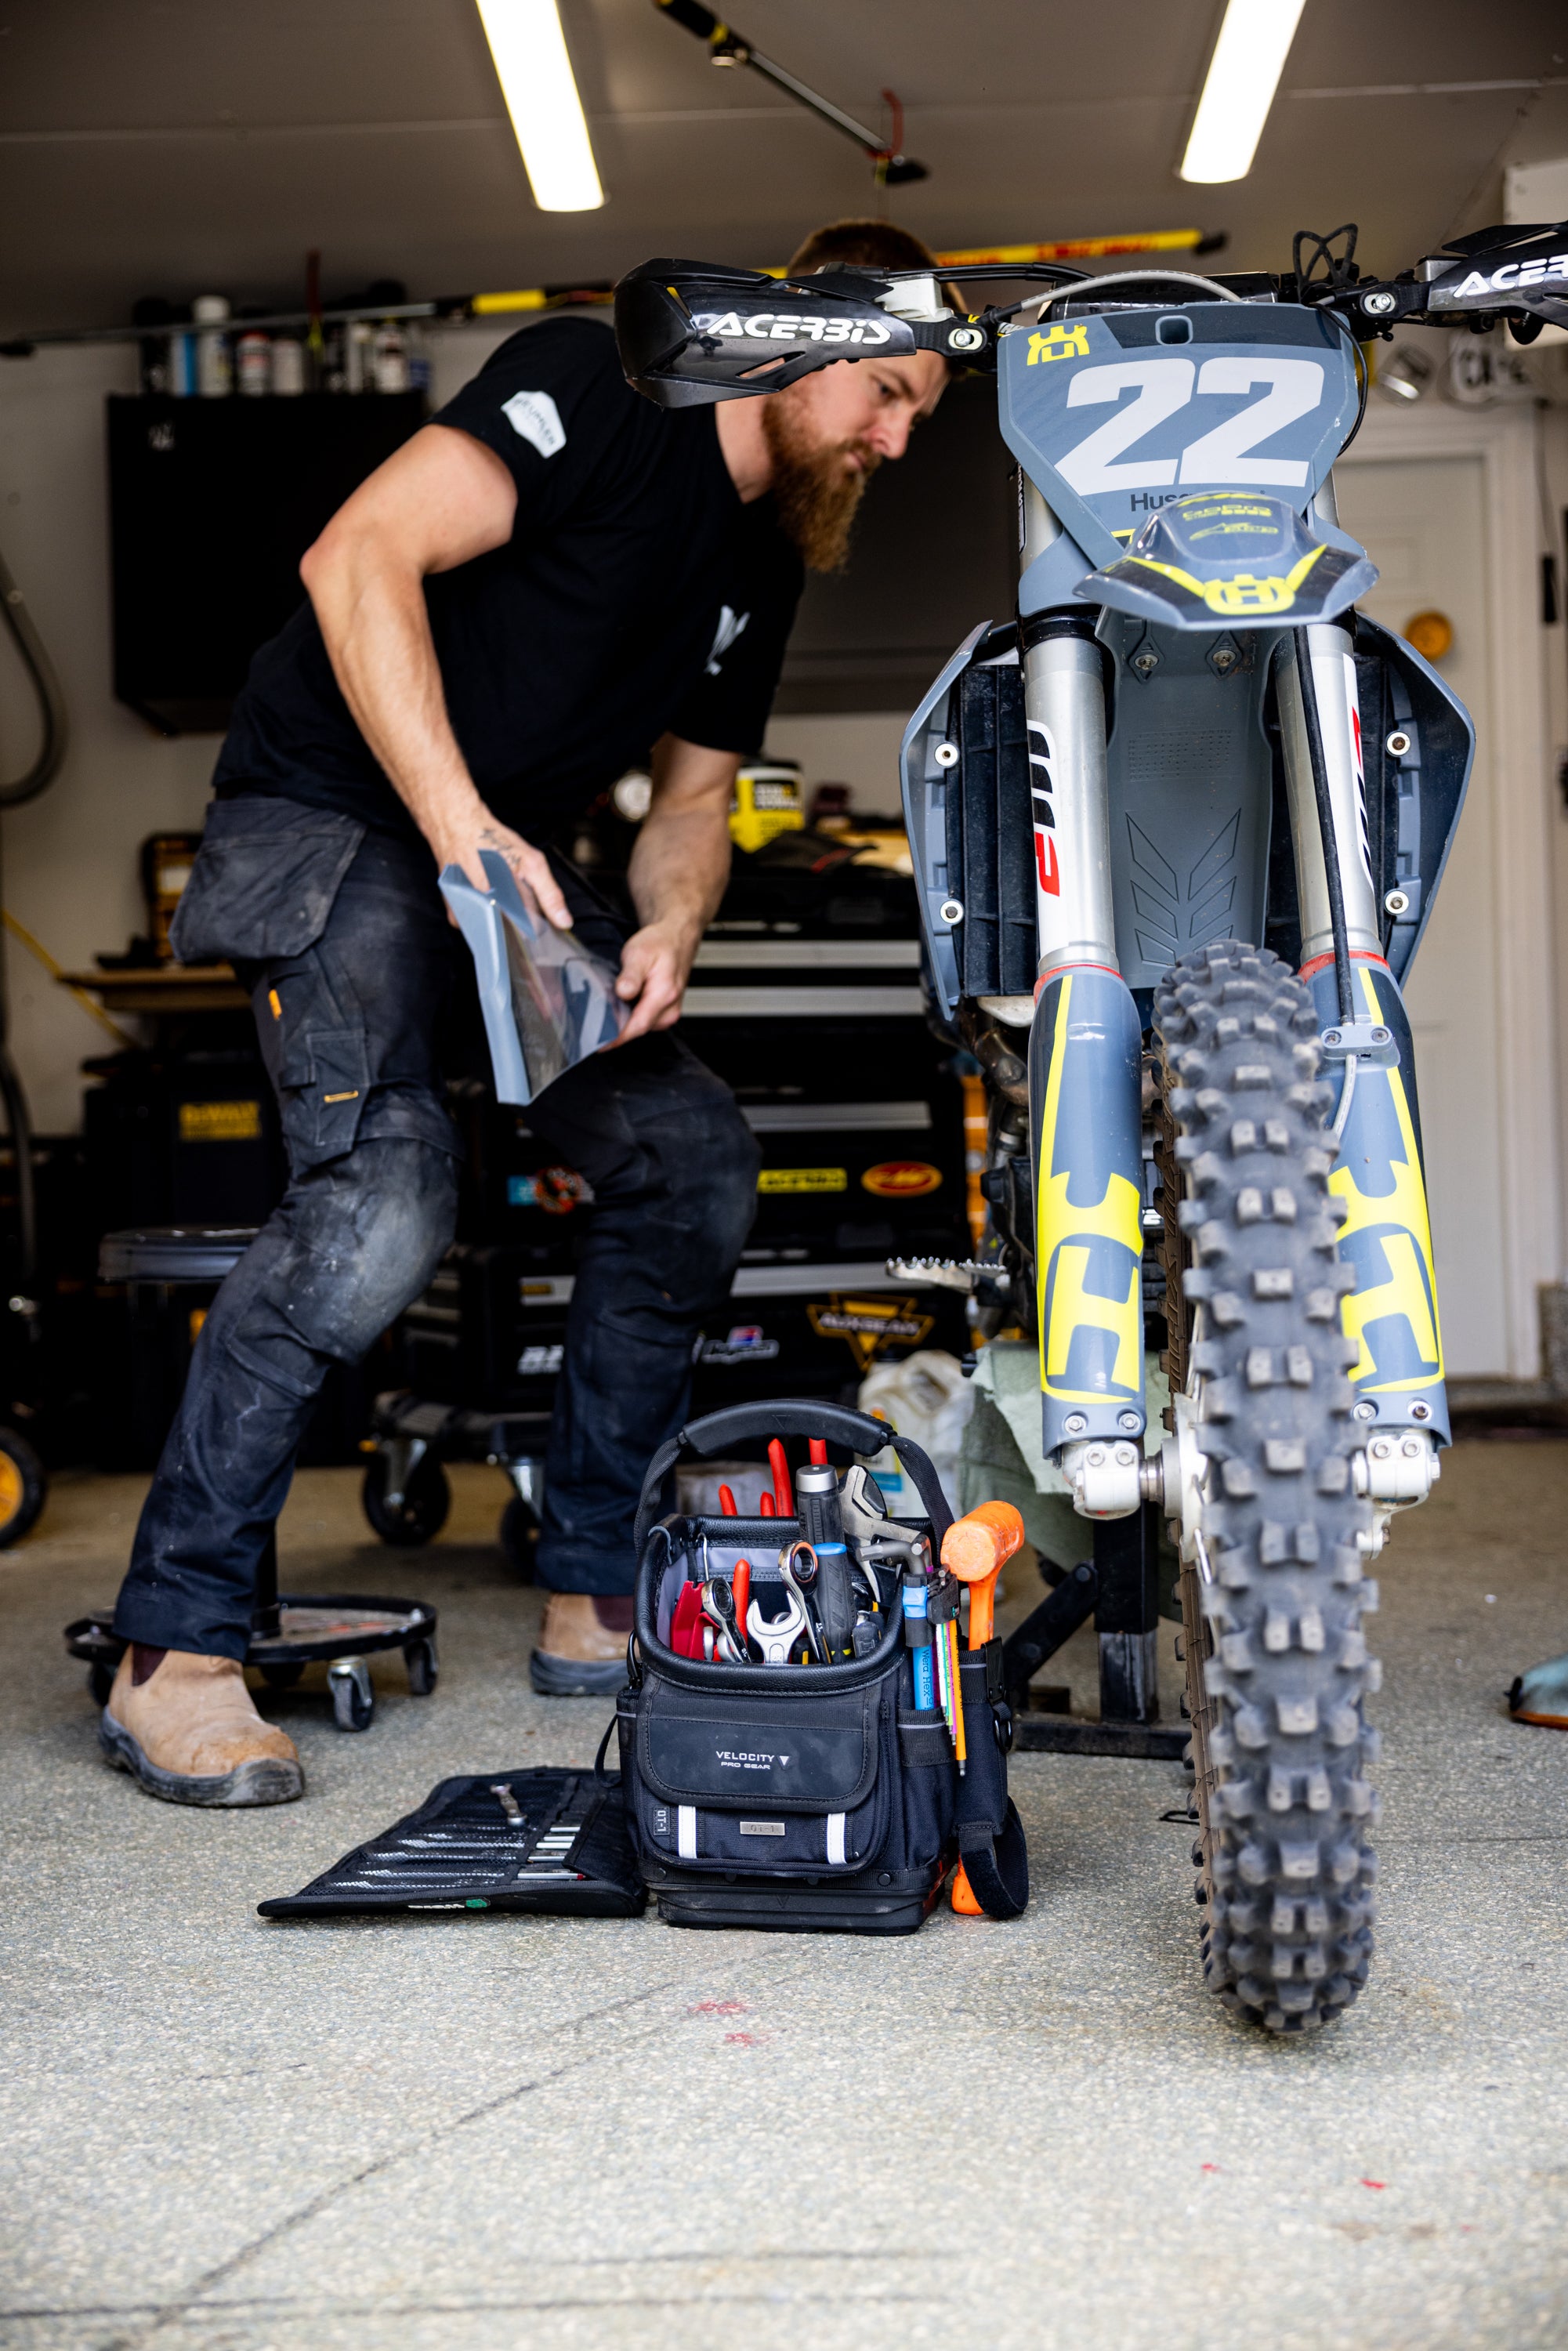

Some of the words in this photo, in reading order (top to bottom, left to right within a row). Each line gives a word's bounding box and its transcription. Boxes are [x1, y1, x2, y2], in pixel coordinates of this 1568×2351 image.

[706, 312, 883, 345] ACERBIS
[1054, 357, 1324, 496] 22
[715, 1751, 775, 1762] VELOCITY
